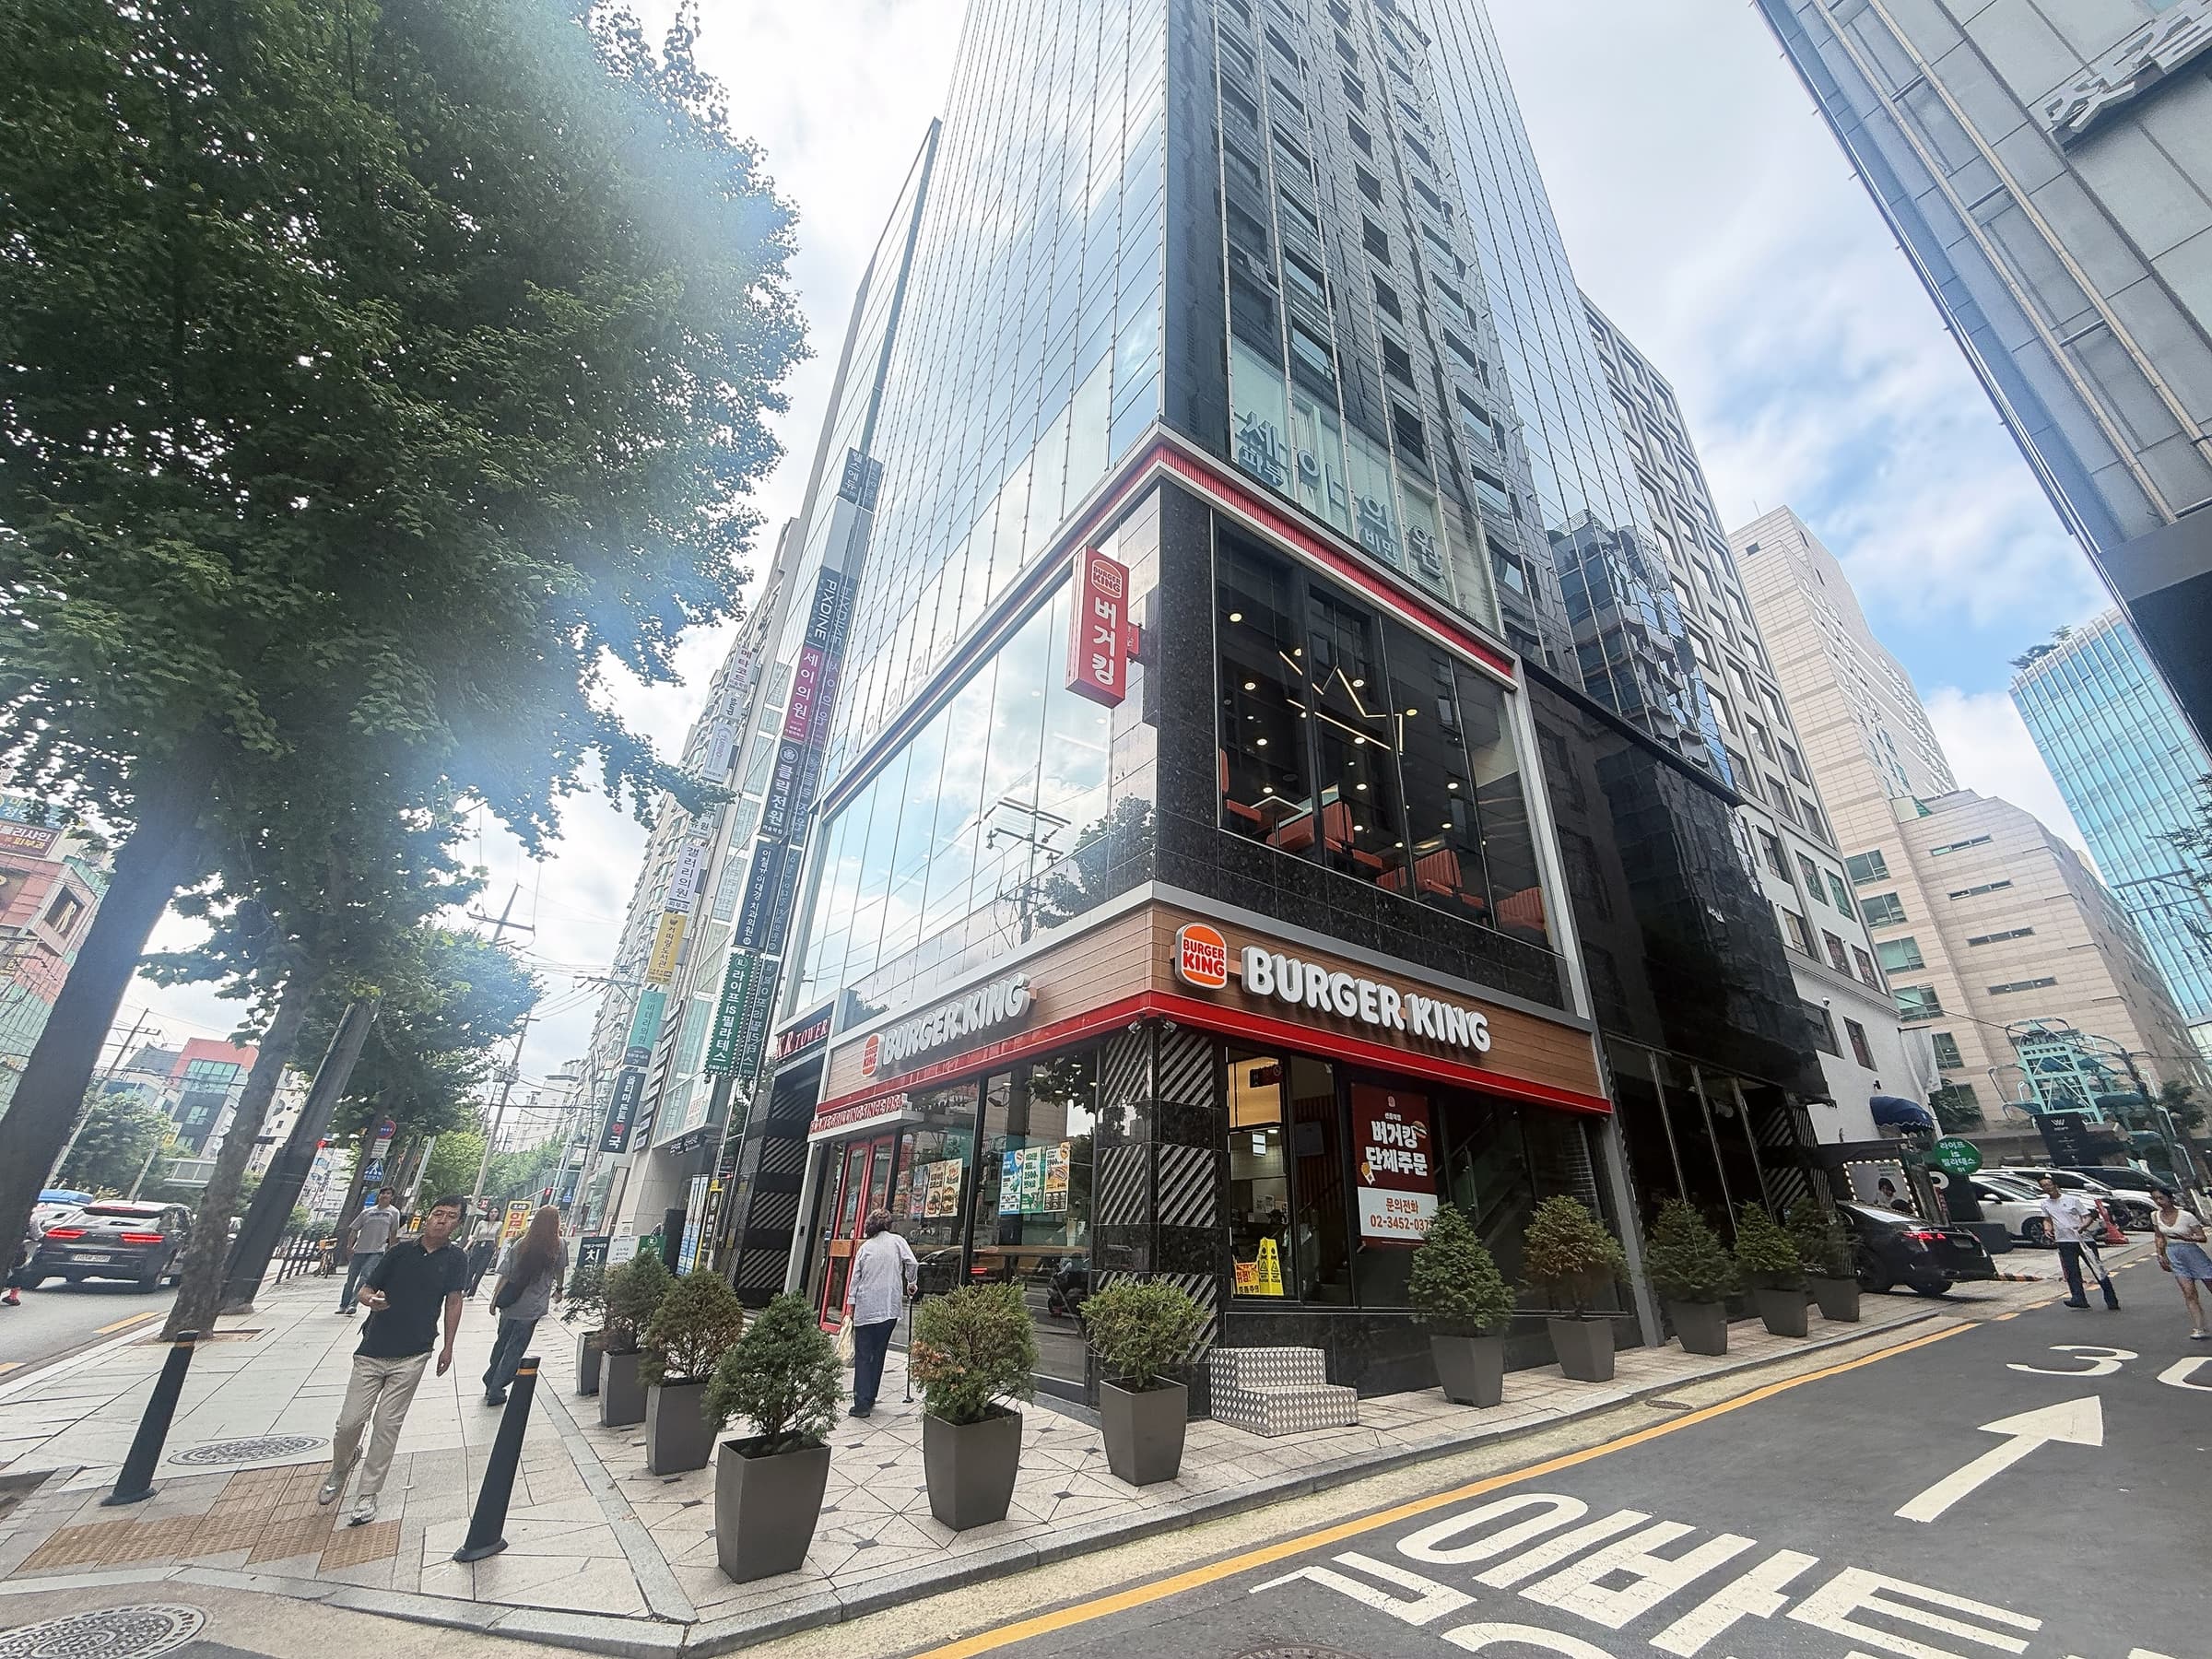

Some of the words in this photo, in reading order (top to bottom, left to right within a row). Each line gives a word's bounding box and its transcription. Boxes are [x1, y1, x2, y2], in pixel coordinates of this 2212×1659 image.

[1092, 572, 1121, 594] KING
[1093, 566, 1121, 585] BURGER
[814, 579, 837, 641] PIXDINE
[1092, 597, 1117, 686] 버거킹
[791, 652, 818, 720] 세이의원
[1183, 939, 1225, 960] BURGER
[1183, 953, 1225, 977] KING
[1241, 946, 1406, 1031] BURGER
[1405, 994, 1490, 1053] KING
[882, 1002, 964, 1065] BURGER
[962, 971, 1031, 1035] KING
[794, 1018, 829, 1049] TOWER
[1939, 1141, 1966, 1150] 라이프
[1949, 1149, 1961, 1158] is
[1365, 1146, 1429, 1177] 단체주문
[1941, 1157, 1977, 1167] 필라테스
[1385, 1197, 1419, 1215] 문의전화
